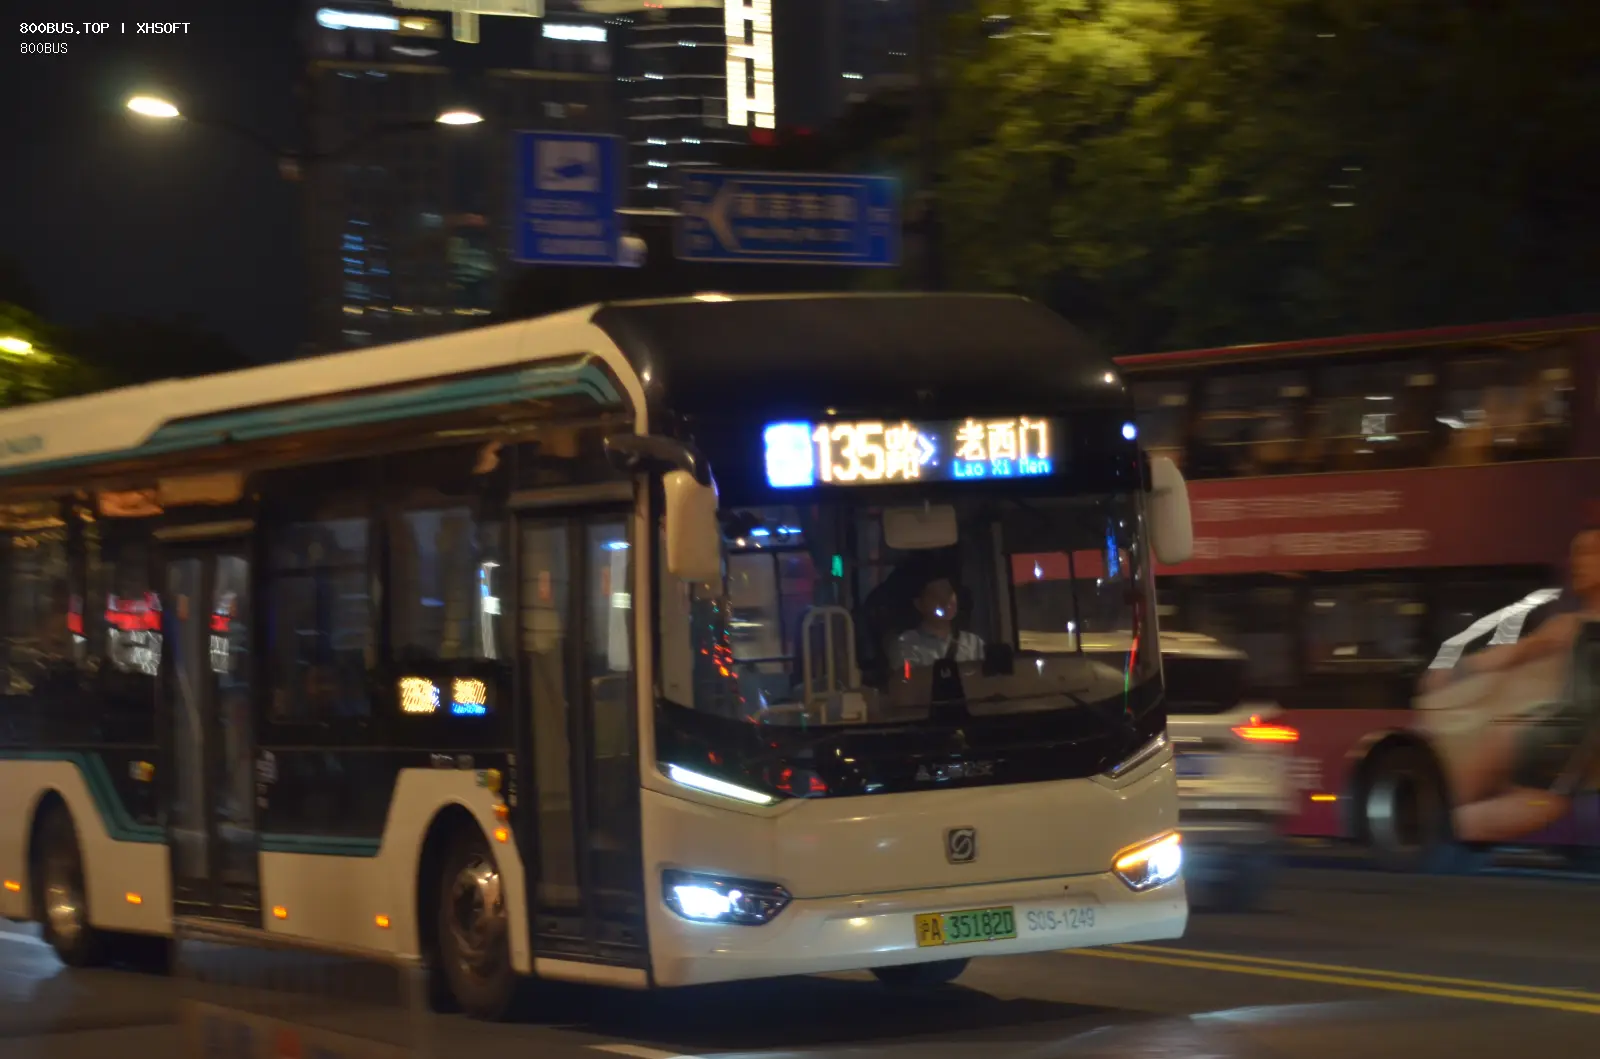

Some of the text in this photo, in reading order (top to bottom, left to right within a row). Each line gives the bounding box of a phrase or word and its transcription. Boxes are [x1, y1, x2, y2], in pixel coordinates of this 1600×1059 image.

[812, 422, 921, 482] 135路
[955, 417, 1048, 462] 老西门
[954, 458, 1050, 478] Lao Xi Men
